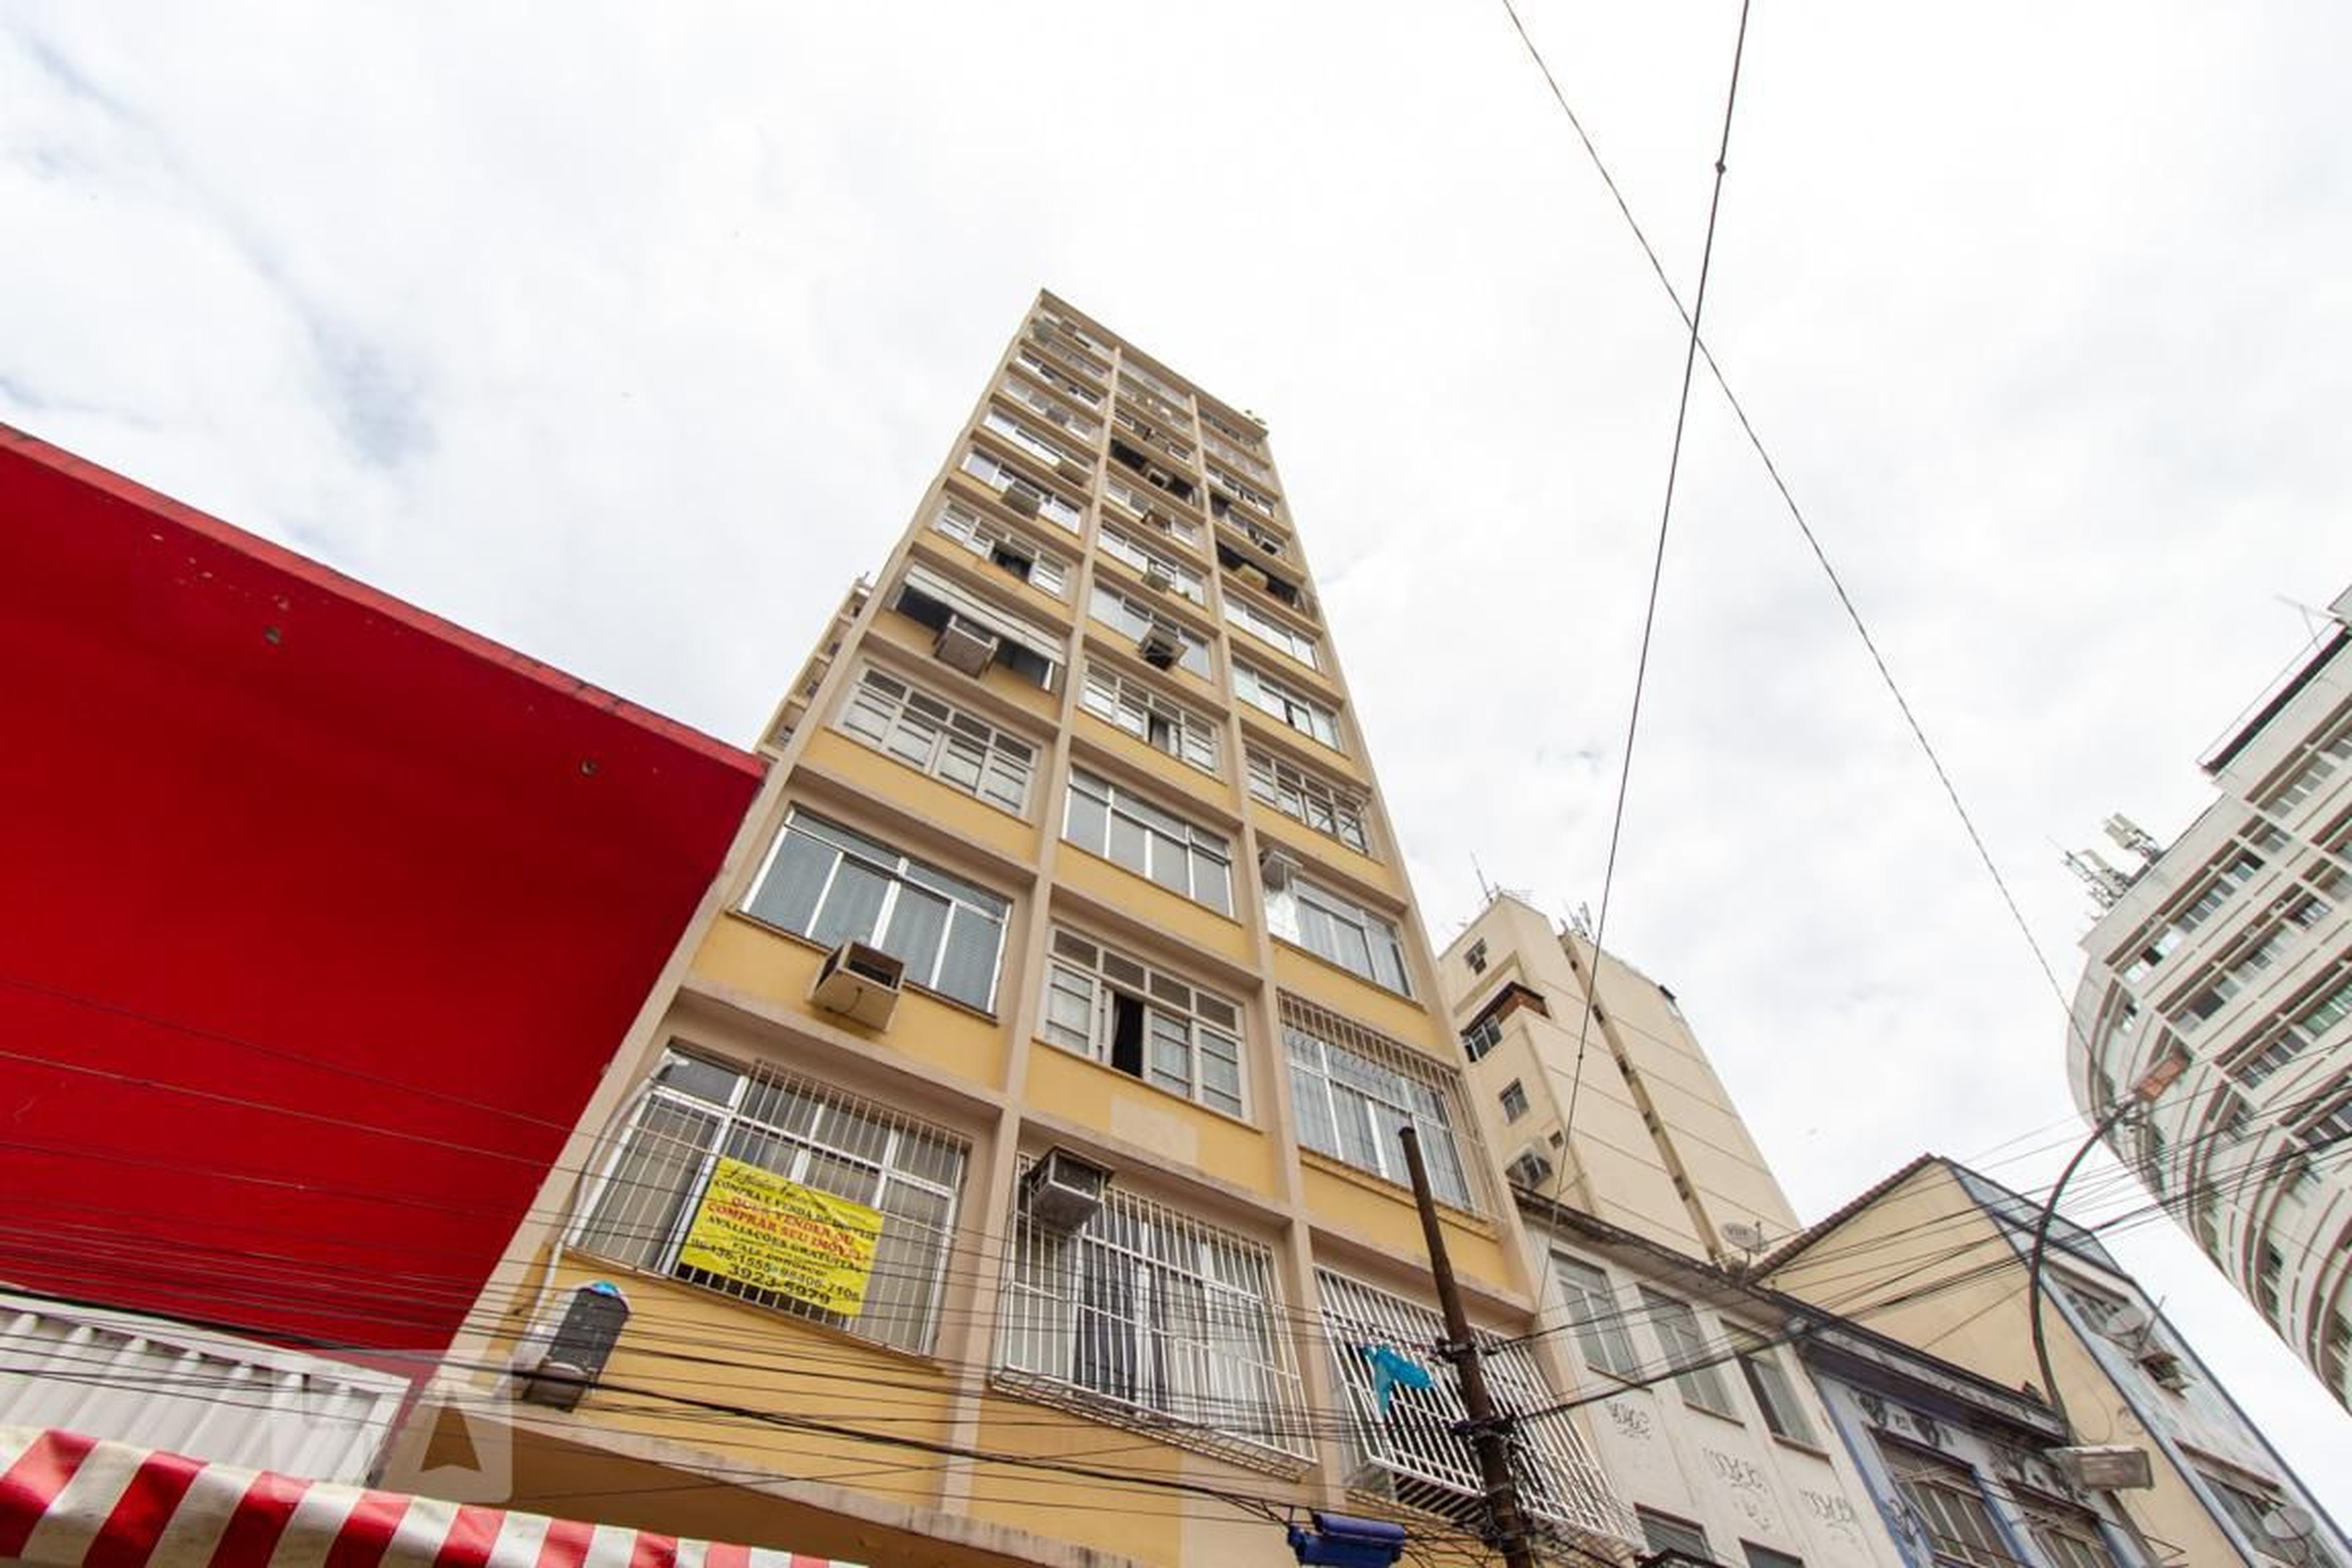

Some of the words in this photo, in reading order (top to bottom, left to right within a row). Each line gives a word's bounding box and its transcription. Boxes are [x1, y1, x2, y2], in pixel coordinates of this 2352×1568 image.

[706, 1200, 778, 1232] COMPRAR
[780, 1225, 809, 1243] SEU
[831, 1218, 878, 1242] IMVEIS
